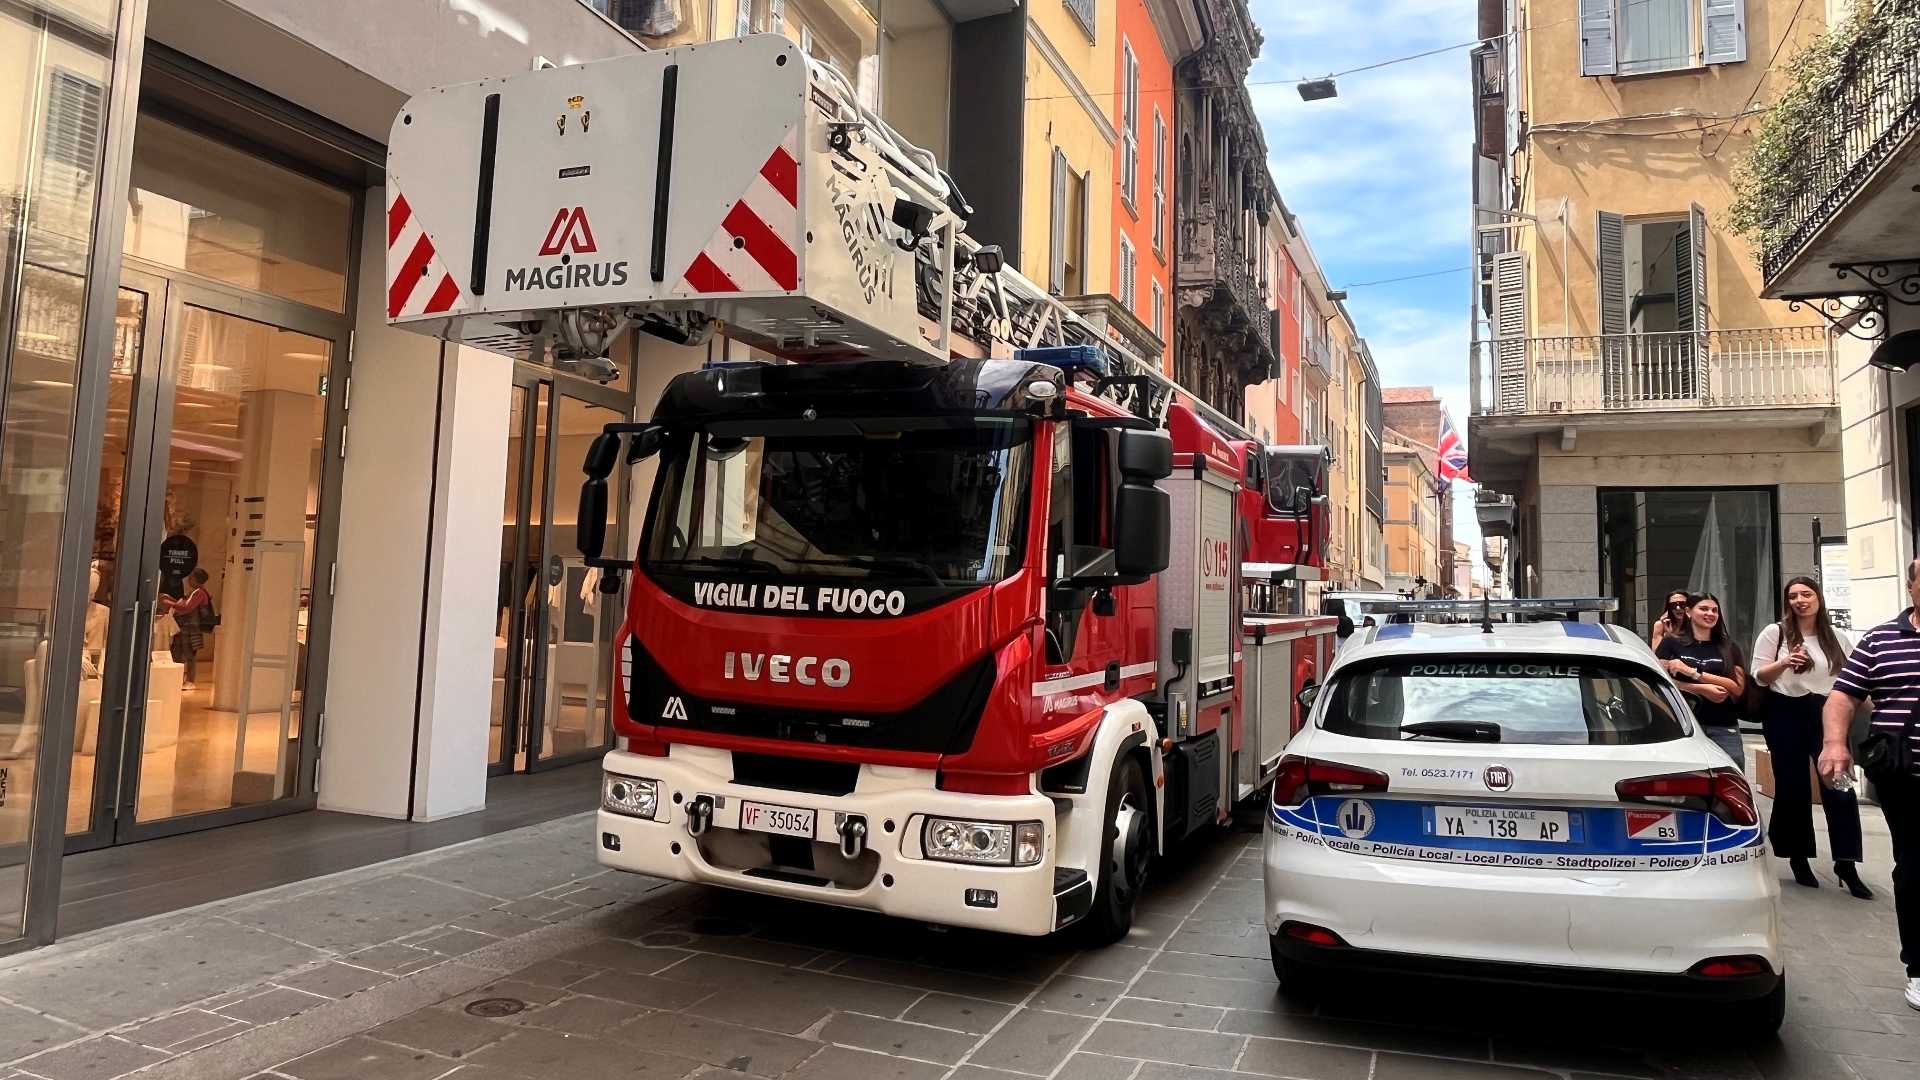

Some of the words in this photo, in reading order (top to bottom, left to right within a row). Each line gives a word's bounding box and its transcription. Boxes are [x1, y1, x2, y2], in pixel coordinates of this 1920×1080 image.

[825, 174, 876, 305] MAGIRUS
[505, 261, 628, 291] MAGIRUS
[1214, 540, 1228, 578] 115
[694, 581, 757, 608] VIGILI
[763, 585, 809, 611] DEL
[817, 587, 905, 616] FUOCO
[724, 651, 851, 688] IVECO
[1409, 664, 1489, 676] POLIZIA
[1496, 664, 1581, 677] LOCALE
[1401, 767, 1418, 777] Tel.
[1421, 768, 1474, 780] 0523.7171
[1490, 771, 1506, 784] FIAT
[746, 807, 760, 825] VF
[769, 810, 810, 832] 35054
[1465, 808, 1498, 818] POLIZIA
[1502, 811, 1536, 820] LOCALE
[1445, 817, 1465, 836] YA
[1488, 819, 1518, 838] 138
[1540, 822, 1559, 840] AP
[1658, 827, 1675, 838] B3
[1372, 843, 1415, 857] Policia
[1419, 847, 1454, 860] Local
[1465, 853, 1499, 864] Local
[1503, 854, 1543, 866] Police
[1557, 857, 1636, 870] Stadtpolizei
[1650, 857, 1690, 867] Police
[1721, 850, 1748, 864] Local
